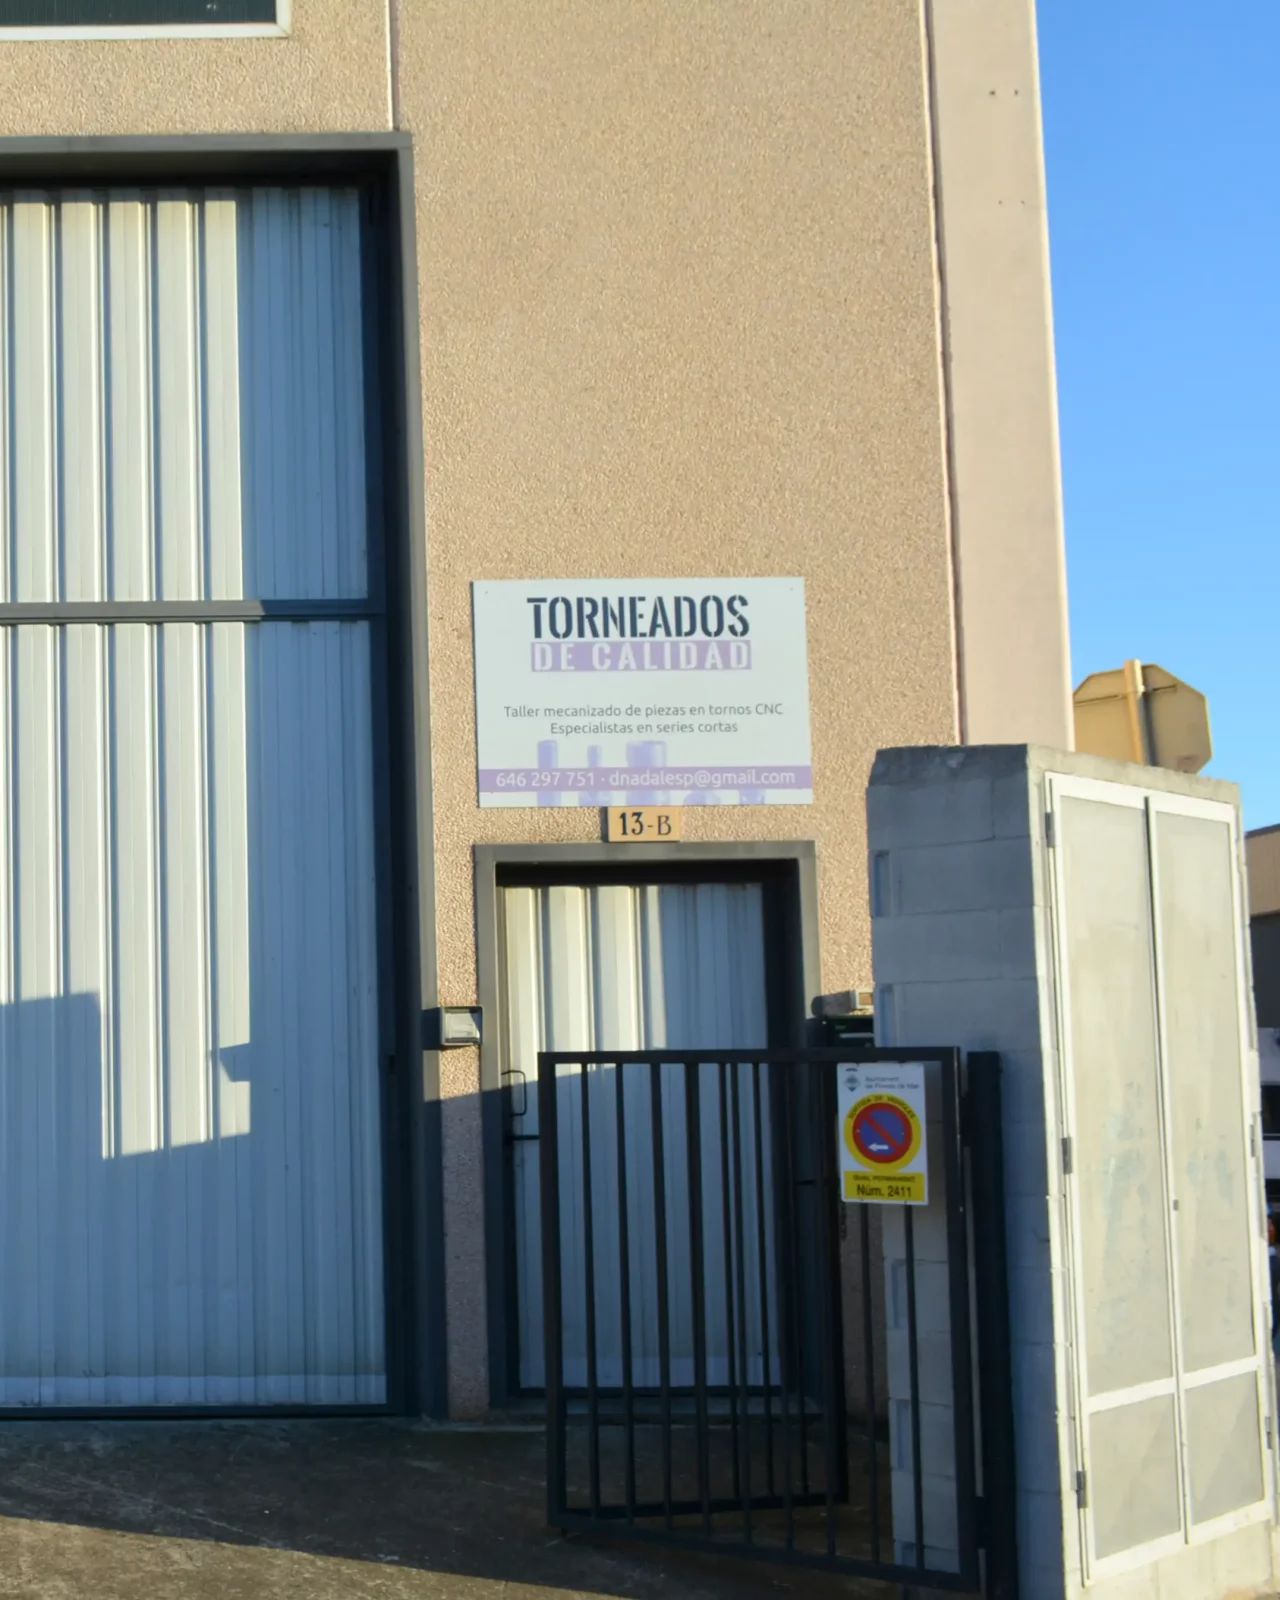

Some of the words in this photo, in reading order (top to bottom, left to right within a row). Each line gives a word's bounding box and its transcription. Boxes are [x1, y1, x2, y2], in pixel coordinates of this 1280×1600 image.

[526, 594, 750, 639] TORNEADOS
[534, 642, 575, 671] DE
[591, 640, 750, 671] CALIDAD
[503, 705, 540, 718] Taller
[543, 704, 622, 717] mecanizado
[624, 704, 641, 717] de
[645, 704, 686, 719] piezas
[689, 705, 706, 716] en
[708, 704, 752, 716] tornos
[755, 703, 784, 716] CNC
[550, 721, 634, 737] Especialistas
[636, 723, 653, 734] en
[656, 720, 695, 734] series
[697, 721, 739, 734] cortas
[495, 771, 527, 787] 646
[531, 771, 561, 787] 297
[565, 771, 595, 787] 751
[609, 768, 796, 788] dnadalesp@gmail.com
[619, 811, 672, 836] 13-B
[856, 1183, 884, 1197] Núm.
[887, 1184, 912, 1198] 2411
